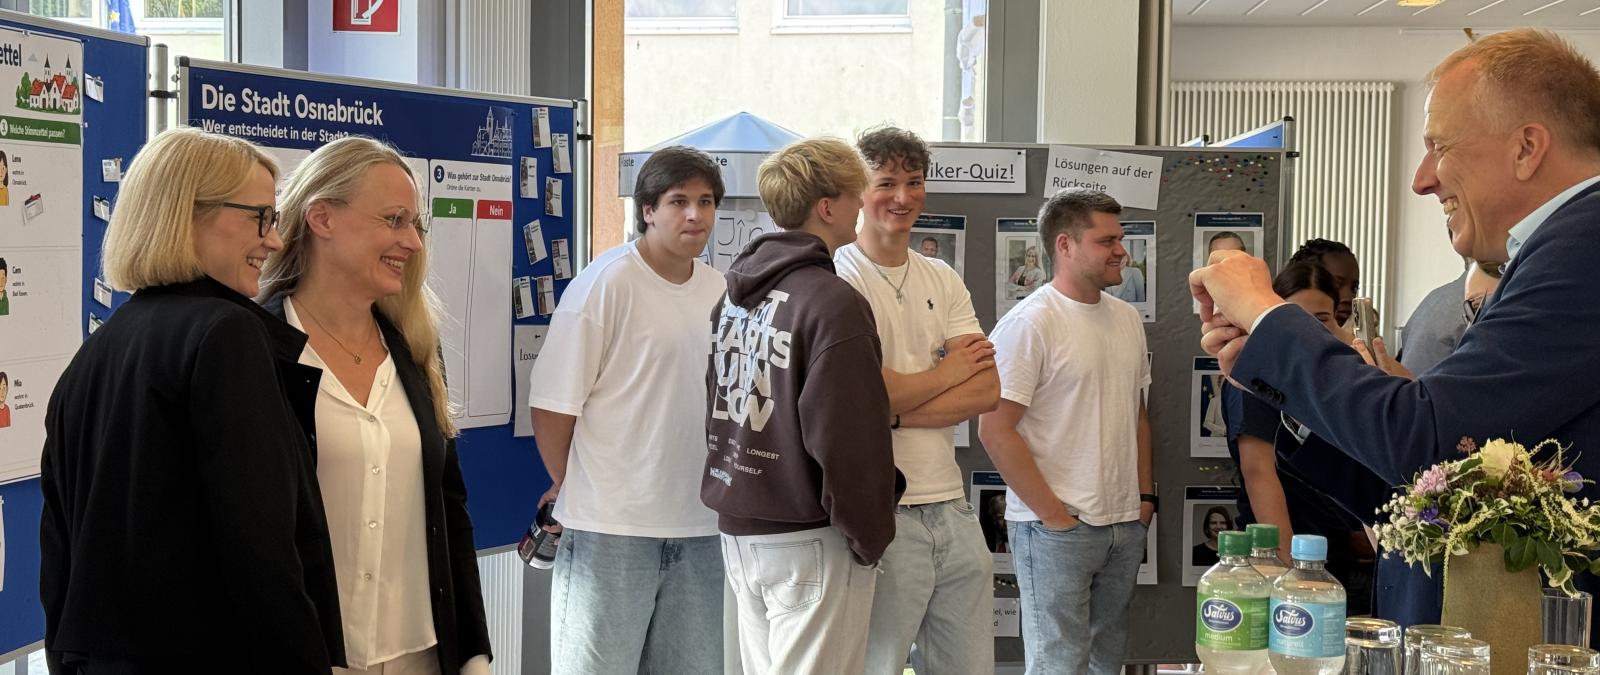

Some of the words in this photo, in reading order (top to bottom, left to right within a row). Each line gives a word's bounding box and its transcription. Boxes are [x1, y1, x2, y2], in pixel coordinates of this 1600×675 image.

[201, 83, 236, 112] Die
[241, 87, 290, 117] Stadt
[294, 93, 383, 126] Osnabrück
[9, 123, 24, 135] Welche
[202, 118, 225, 134] Wer
[228, 123, 288, 139] entscheidet
[290, 127, 299, 140] in
[302, 128, 317, 141] der
[319, 129, 349, 142] Stadt?
[437, 168, 442, 179] 3
[447, 172, 456, 180] Was
[457, 173, 471, 182] gehört
[480, 173, 491, 182] Stadt
[1054, 157, 1109, 176] Lösungen
[1112, 165, 1131, 178] auf
[1133, 167, 1154, 180] der
[1052, 176, 1107, 192] Rückseite
[448, 203, 457, 214] Ja
[489, 204, 504, 216] Nein
[746, 447, 780, 460] LONGEST
[1004, 608, 1017, 616] wie
[1204, 632, 1233, 643] medium
